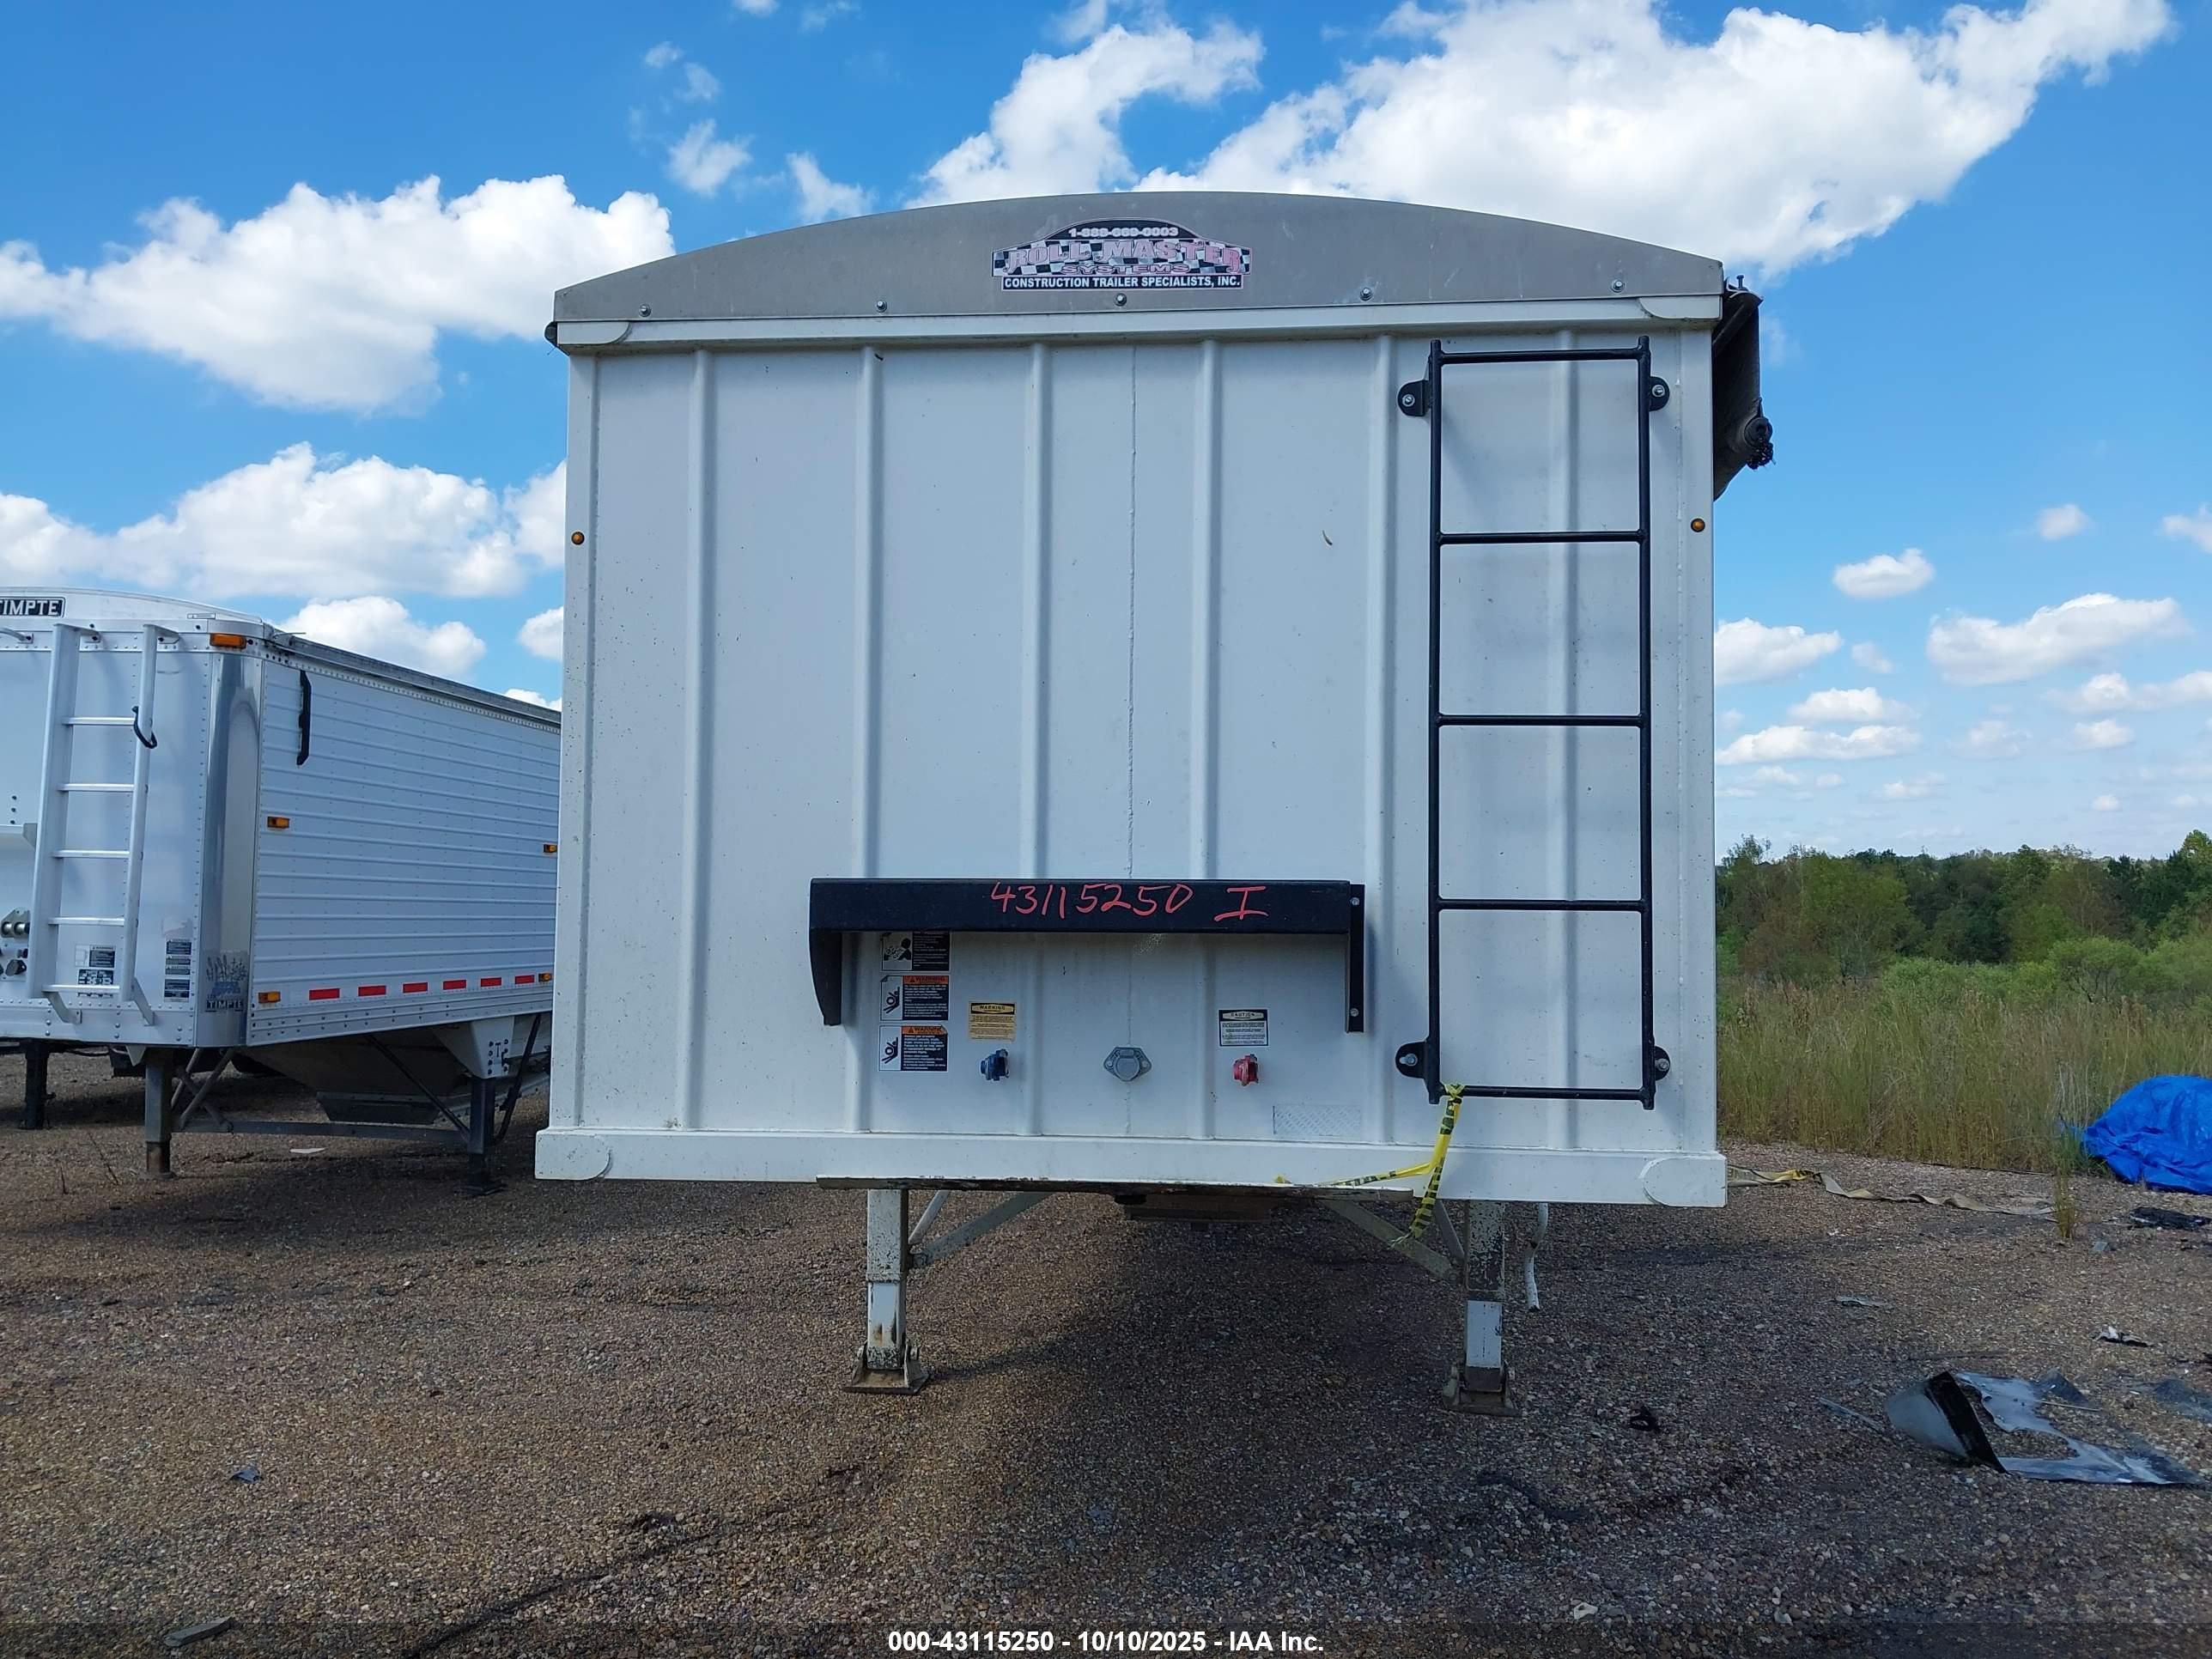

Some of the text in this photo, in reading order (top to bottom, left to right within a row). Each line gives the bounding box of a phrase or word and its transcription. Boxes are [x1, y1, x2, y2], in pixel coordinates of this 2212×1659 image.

[1003, 240, 1241, 275] ROLL MASTER
[1060, 264, 1190, 275] SYSTEMS
[1005, 276, 1240, 288] CONSTRUCTION TRAILER SPECIALISTS, INC.
[989, 882, 1194, 919] 43115250
